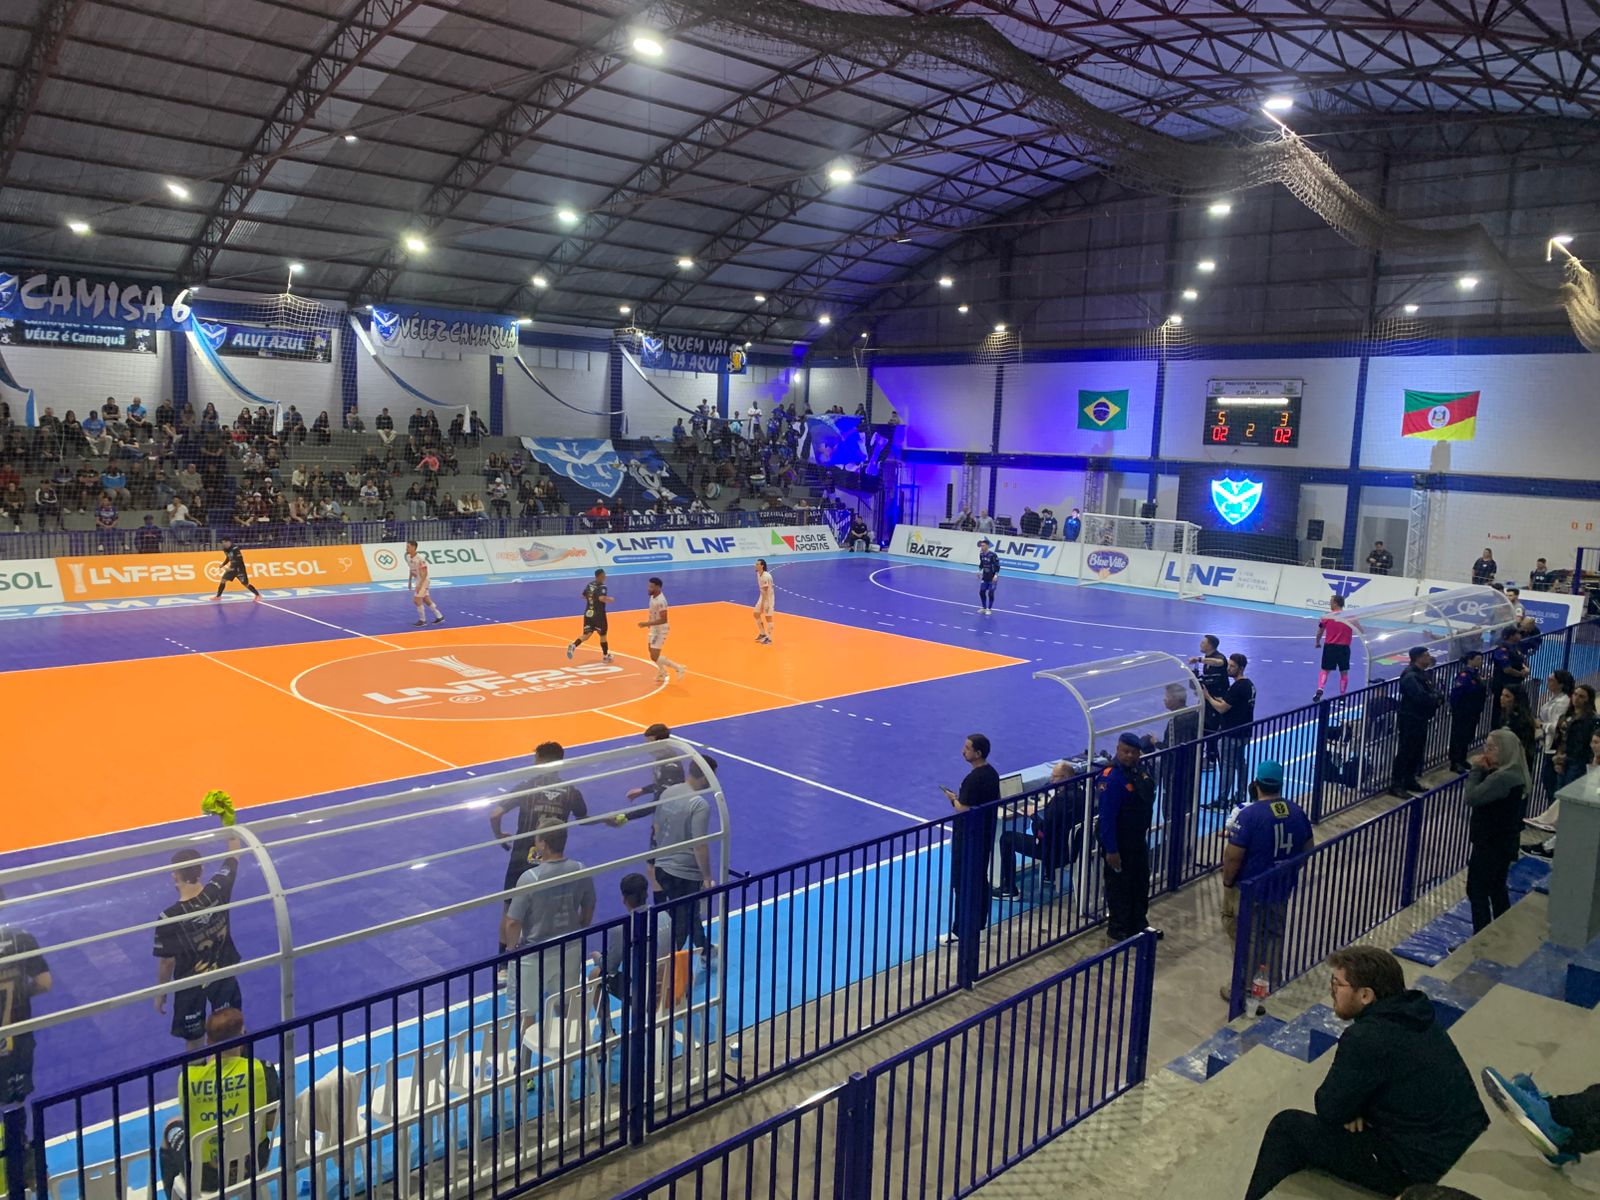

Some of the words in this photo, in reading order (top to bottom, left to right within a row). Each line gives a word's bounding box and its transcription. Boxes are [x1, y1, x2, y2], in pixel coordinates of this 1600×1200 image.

[20, 273, 166, 323] CAMISA
[171, 288, 191, 323] 6
[401, 311, 447, 342] VÉLEZ
[25, 327, 58, 341] VÉLEZ
[61, 330, 70, 342] é
[71, 332, 126, 346] Camaquã
[232, 332, 266, 348] ALVI
[268, 334, 306, 350] AZUL
[667, 335, 704, 352] QUEM
[708, 339, 728, 354] VAI
[689, 355, 719, 372] AQUI
[1218, 411, 1226, 425] 5
[1280, 412, 1289, 427] 3
[1212, 426, 1229, 441] 02
[1245, 423, 1255, 437] 2
[1274, 428, 1291, 443] 02
[616, 536, 675, 551] LNFTV
[686, 537, 736, 554] LNF
[795, 534, 815, 543] CASA
[817, 533, 827, 541] DE
[795, 542, 830, 551] APOSTAS
[909, 542, 953, 558] BARTZ
[995, 539, 1057, 559] LNFTV
[89, 564, 196, 585] LNF25
[1165, 560, 1237, 587] LNF
[362, 662, 625, 705] LNF25
[491, 677, 607, 697] CRESOL
[1273, 822, 1293, 858] 14
[196, 1091, 240, 1103] CAMQUA
